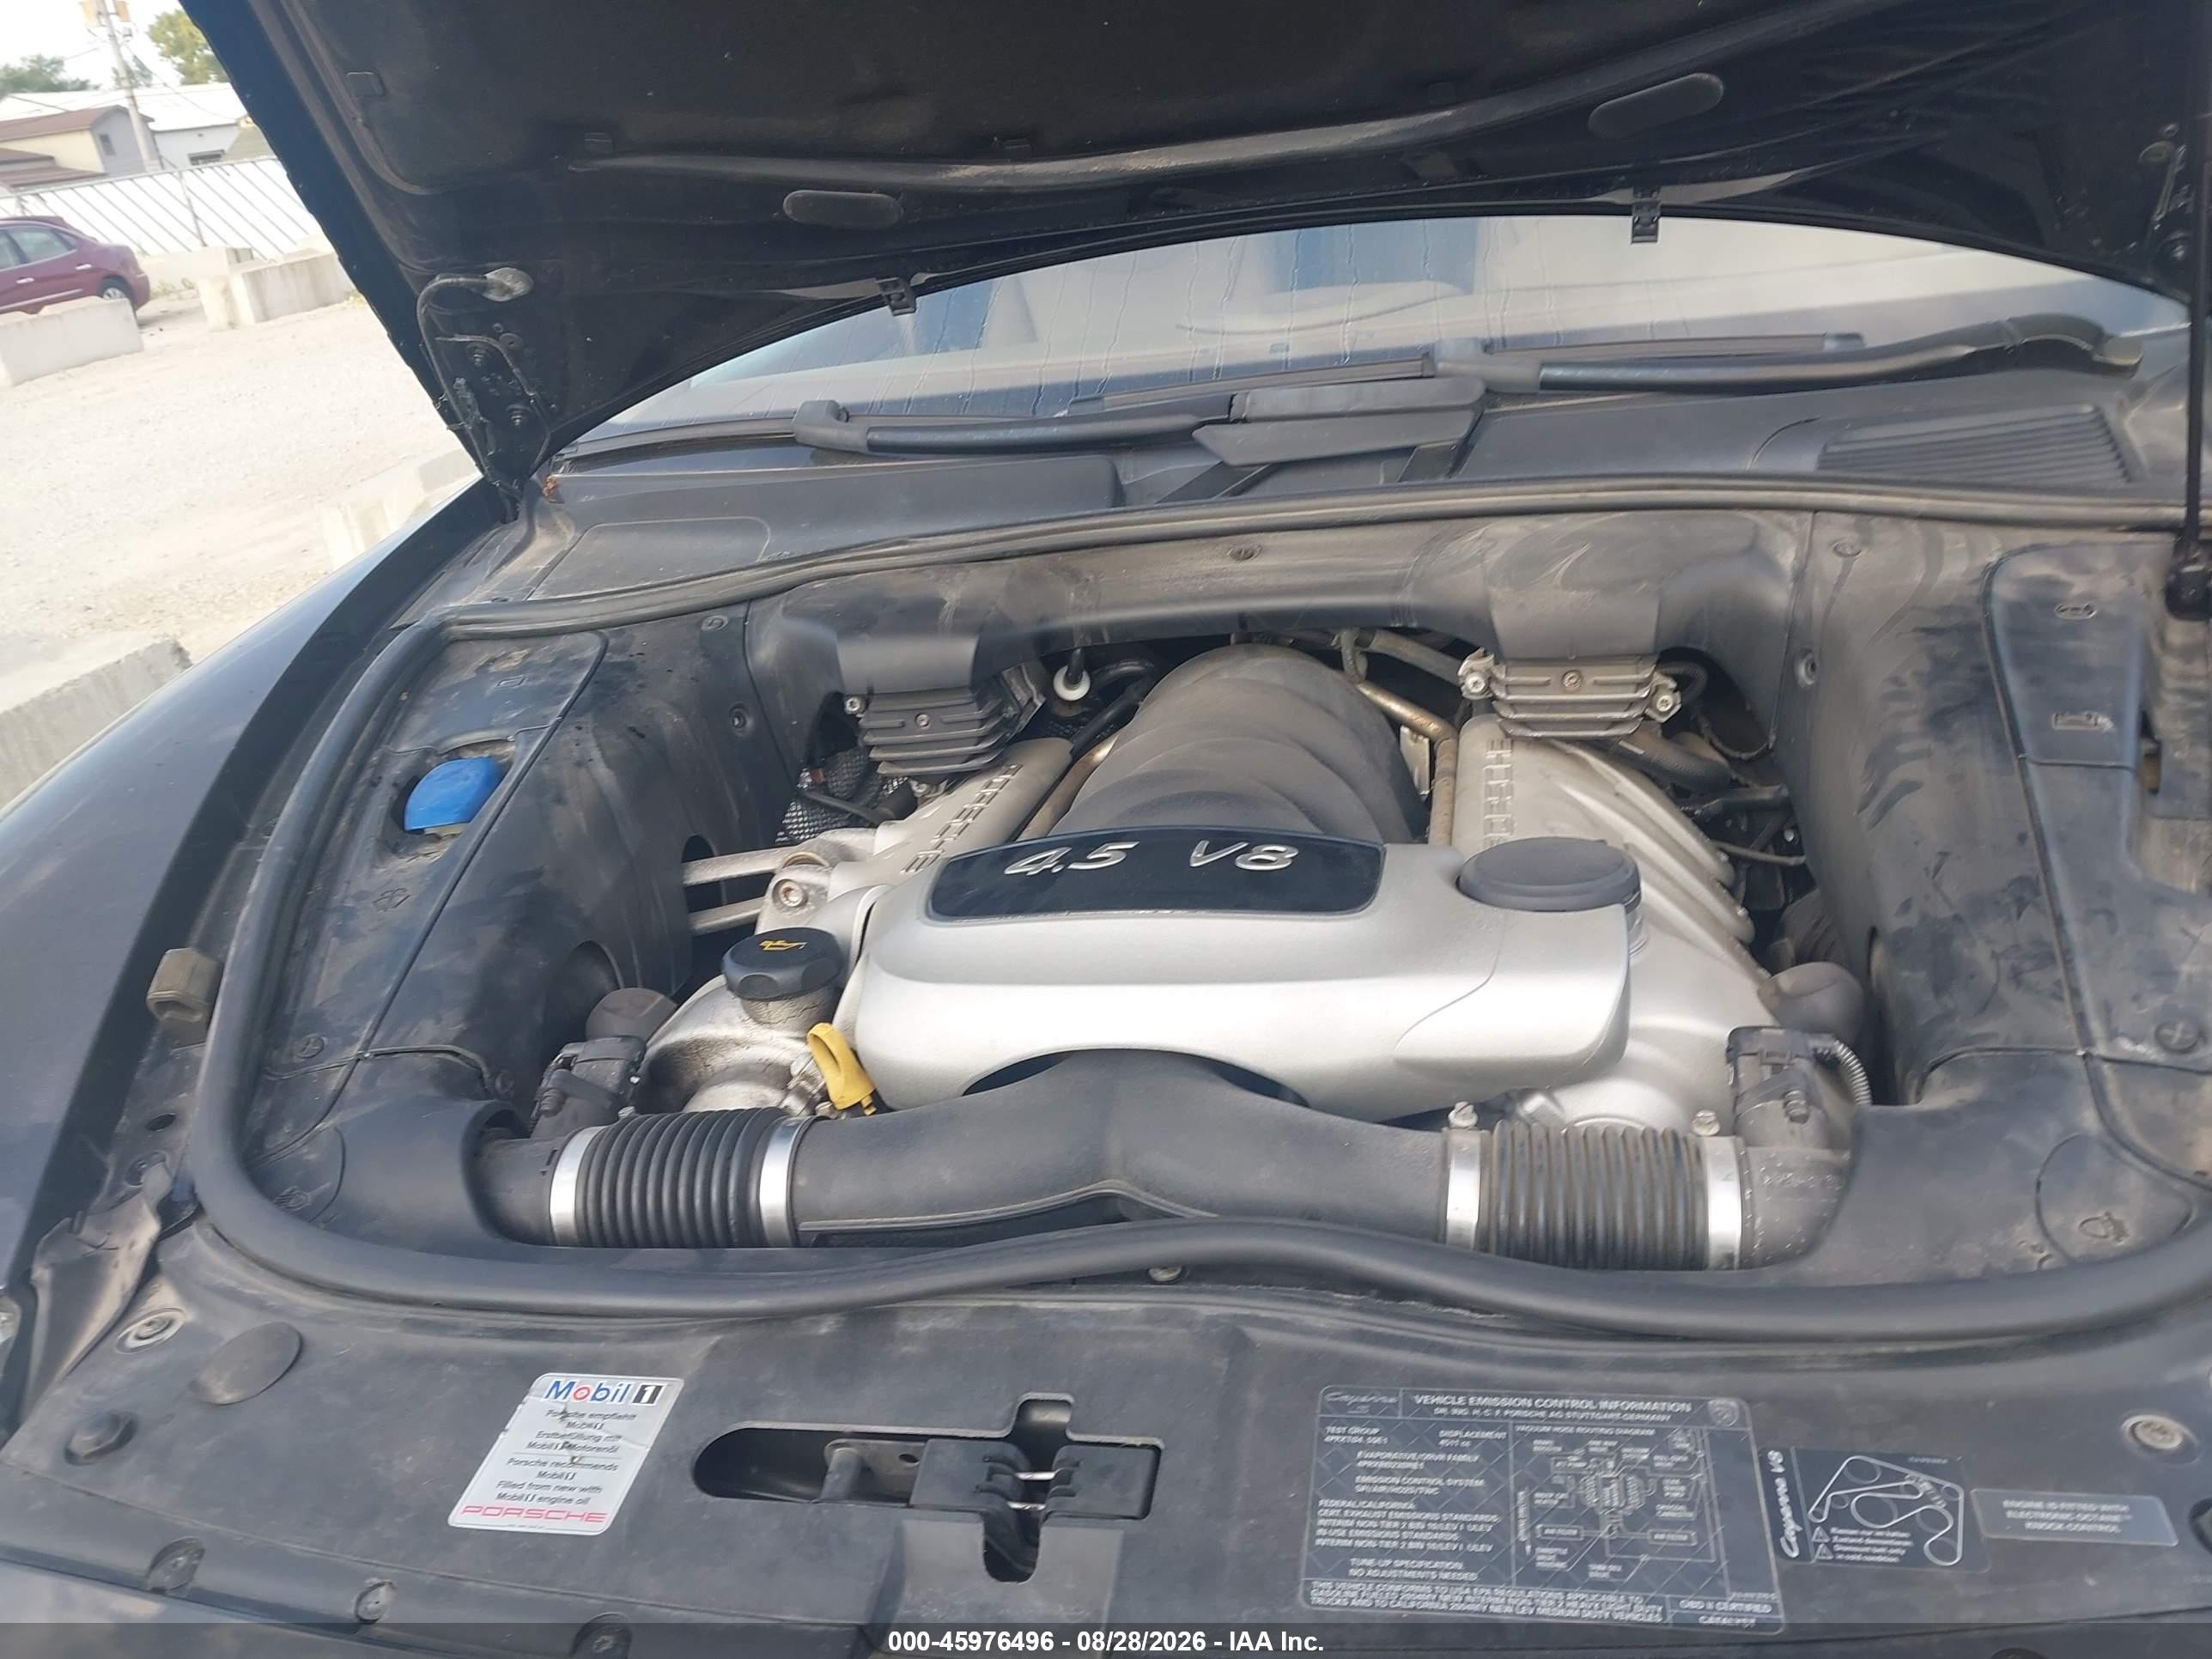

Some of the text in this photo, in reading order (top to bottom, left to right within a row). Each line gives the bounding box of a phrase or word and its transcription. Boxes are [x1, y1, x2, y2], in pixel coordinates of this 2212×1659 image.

[900, 763, 1024, 873] PORSCHE
[1004, 839, 1299, 876] 4.5 V8
[544, 1381, 631, 1402] Mobil
[1413, 1394, 1692, 1412] VEHICLE EMISSION CONTROL INFORMATION
[461, 1505, 608, 1522] PORSCHE
